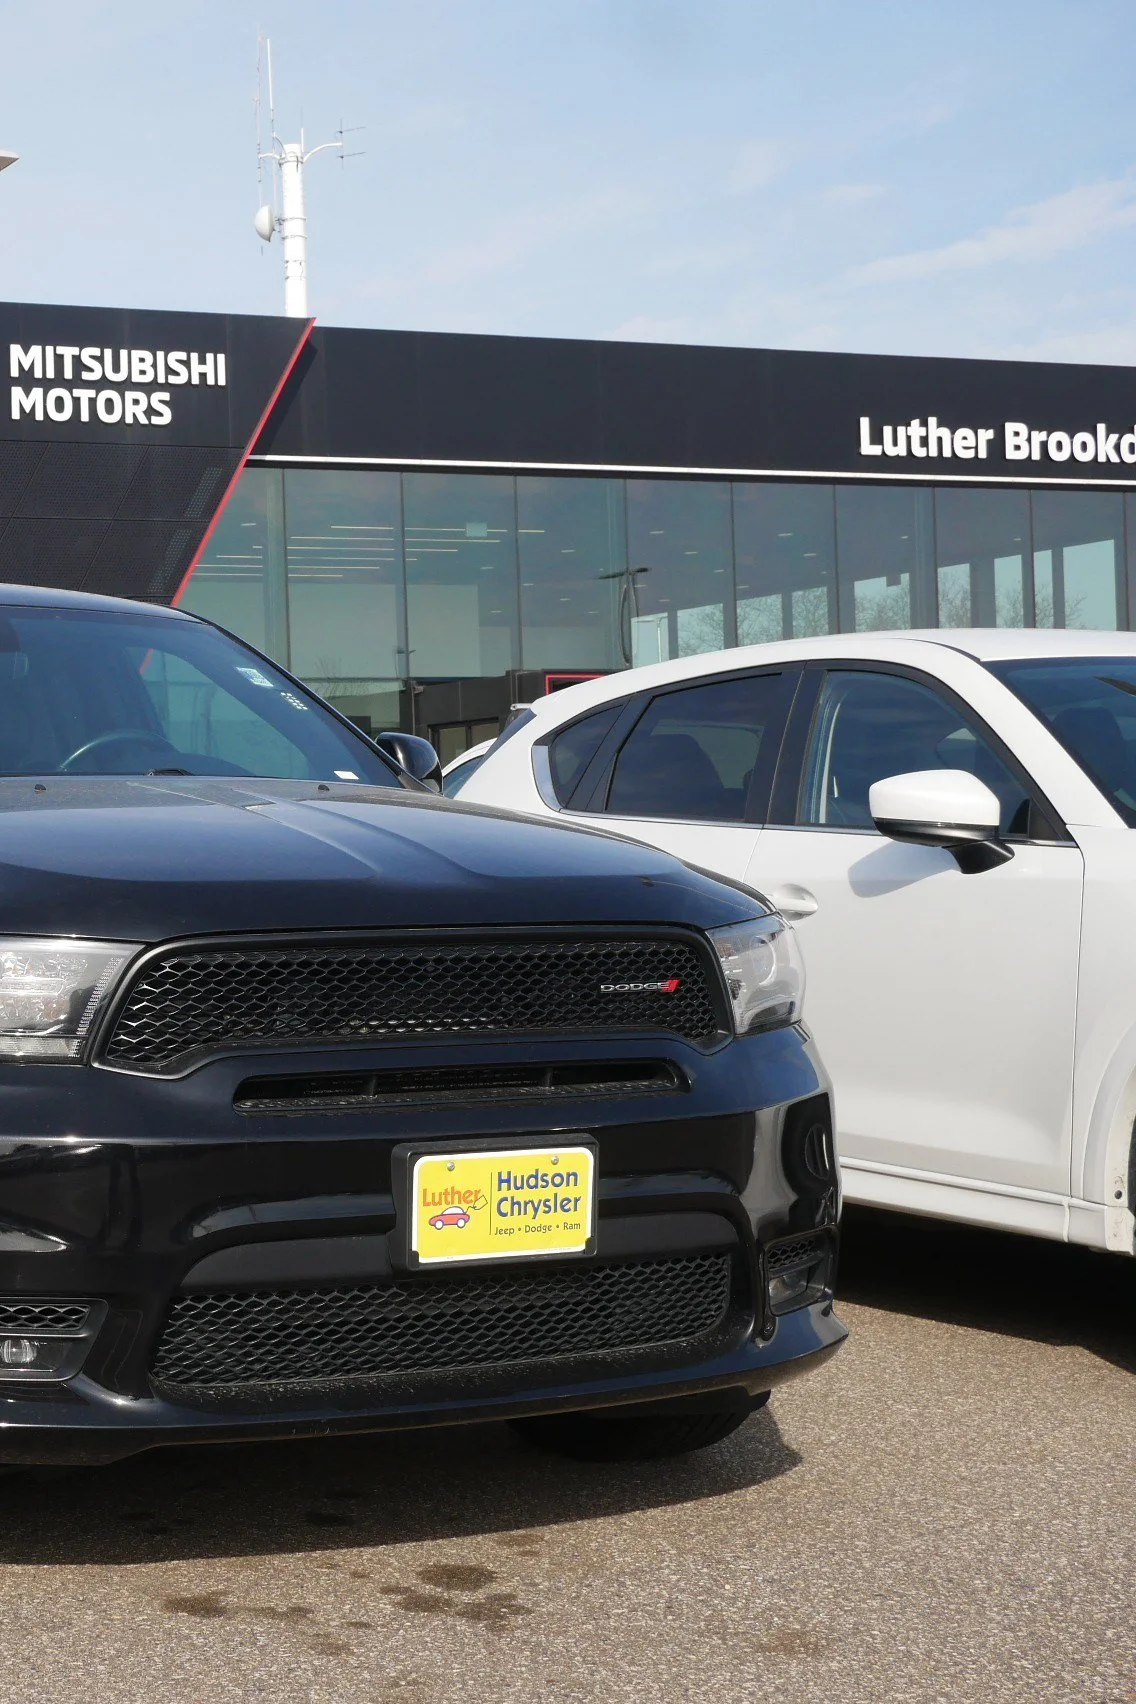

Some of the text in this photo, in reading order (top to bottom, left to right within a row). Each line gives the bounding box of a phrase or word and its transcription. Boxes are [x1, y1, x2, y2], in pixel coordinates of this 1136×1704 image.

[9, 344, 227, 386] MITSUBISHI
[11, 386, 173, 426] MOTORS
[859, 416, 994, 459] Luther
[600, 981, 669, 992] DODGE
[497, 1169, 578, 1191] Hudson
[422, 1186, 481, 1207] Luther
[496, 1193, 582, 1219] Chrysler
[494, 1221, 581, 1236] Jeep Dodge Ram
